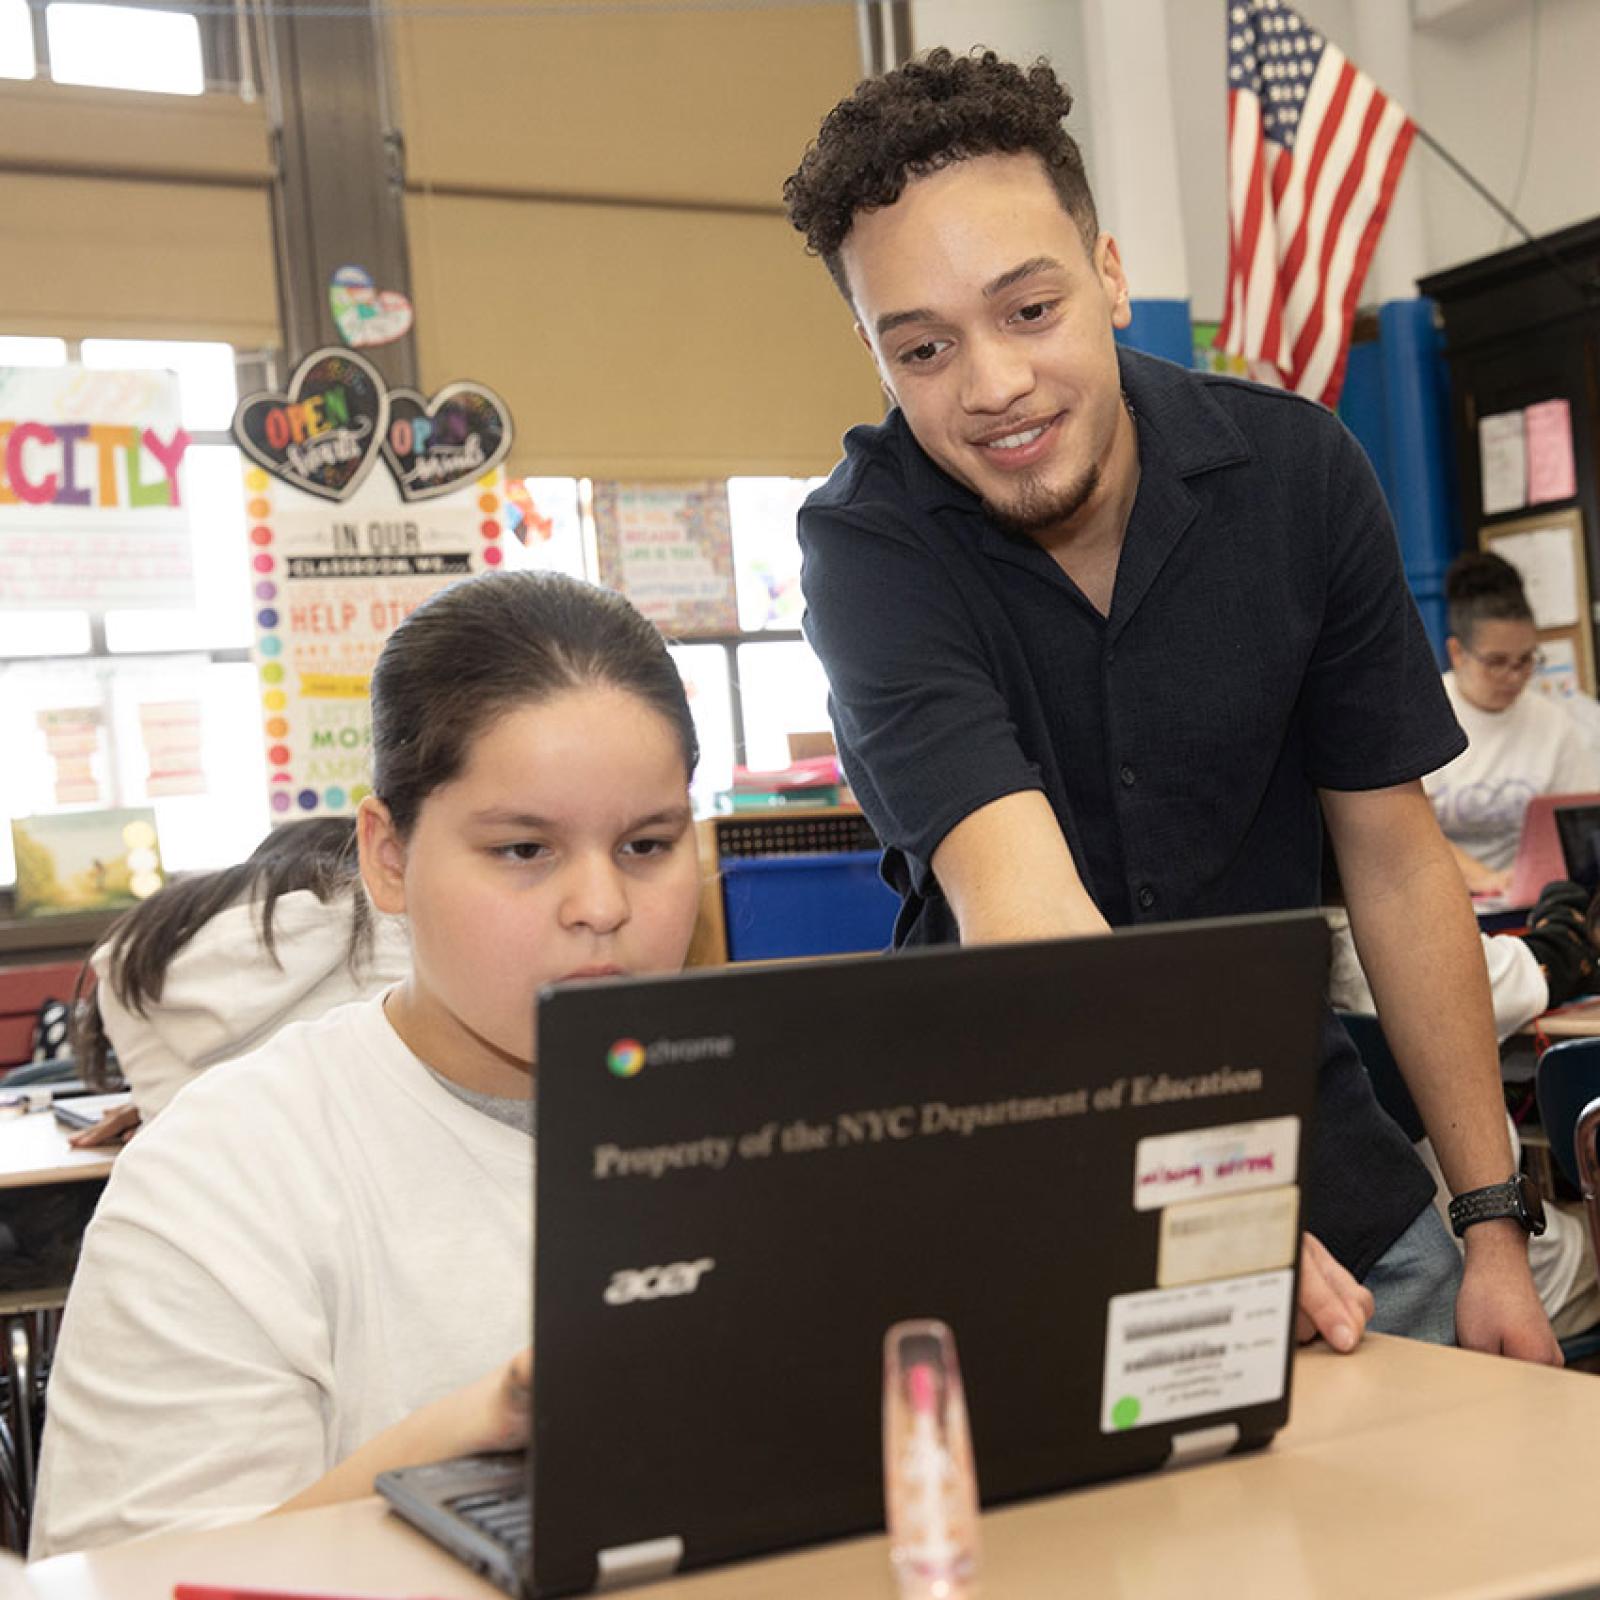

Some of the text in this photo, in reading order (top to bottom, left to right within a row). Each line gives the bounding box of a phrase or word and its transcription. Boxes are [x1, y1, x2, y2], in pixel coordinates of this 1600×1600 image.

[265, 386, 349, 450] OPEN
[332, 521, 420, 553] IN OUR
[290, 601, 358, 634] HELP
[647, 1035, 736, 1065] chrome
[593, 1066, 1263, 1180] Property of the NYC Department of Education
[603, 1256, 716, 1306] acer
